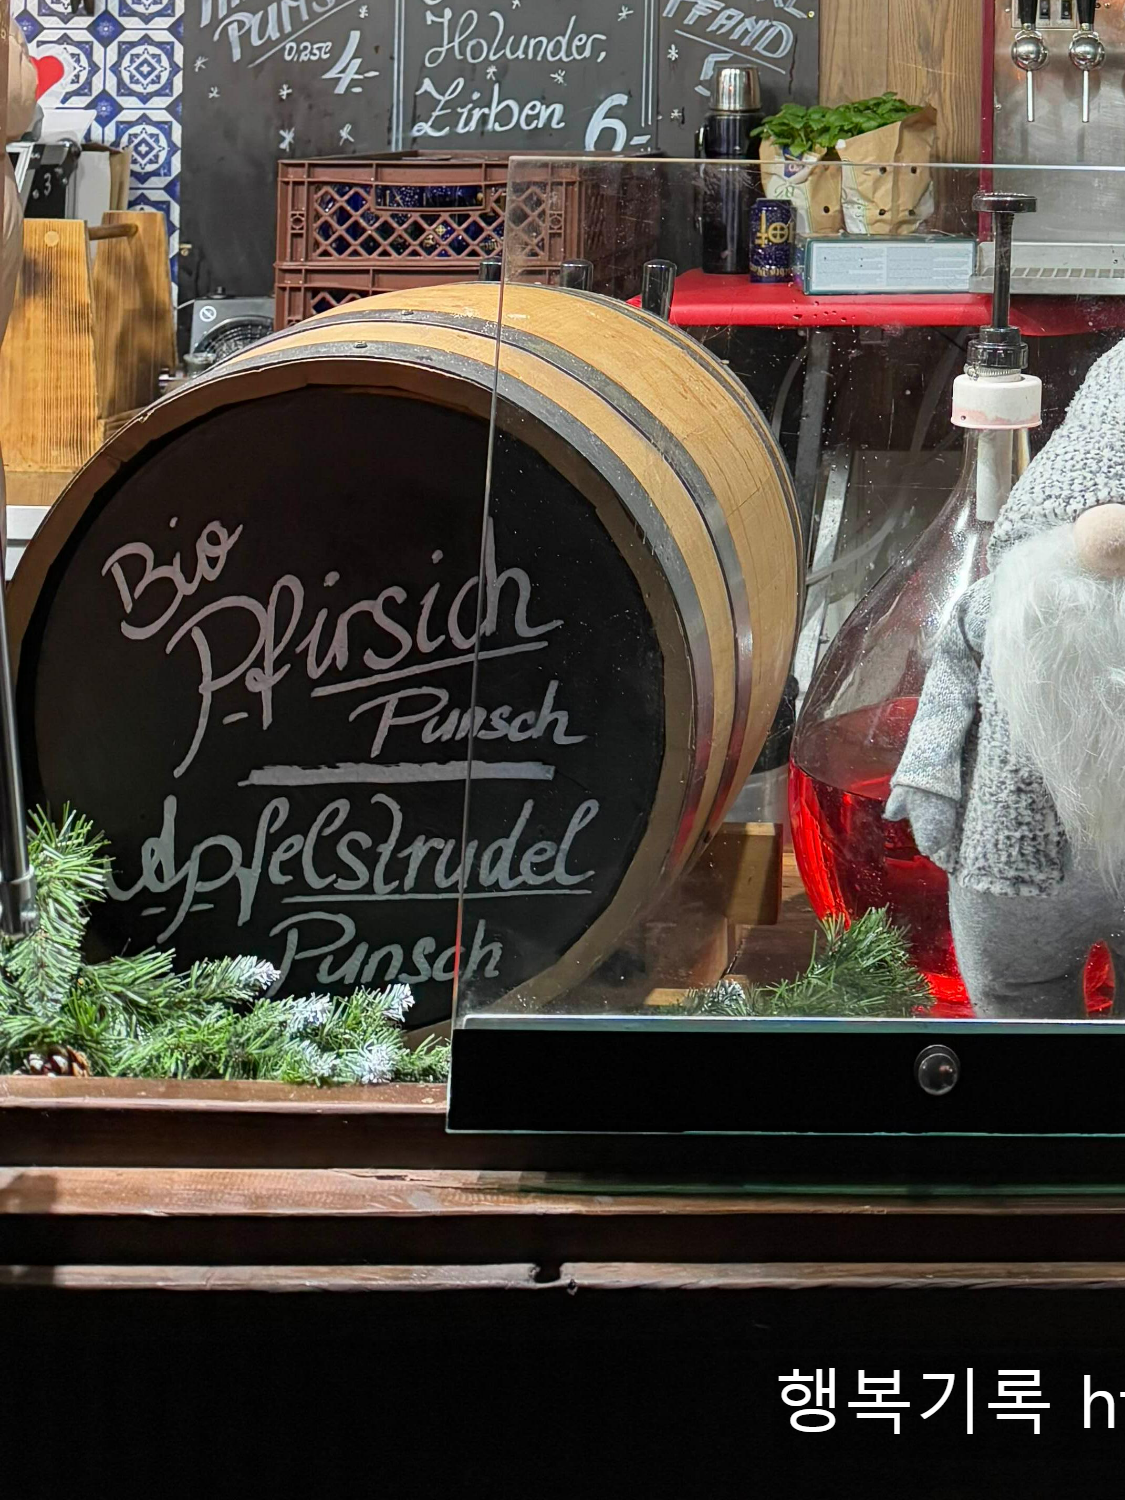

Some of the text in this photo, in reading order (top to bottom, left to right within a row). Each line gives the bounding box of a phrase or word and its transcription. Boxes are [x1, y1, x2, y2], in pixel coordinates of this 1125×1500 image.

[425, 8, 607, 67] Holunder,
[411, 77, 565, 136] Zirben
[101, 517, 243, 640] Bio
[166, 515, 564, 777] Pfirsich
[349, 679, 587, 757] Punsch
[269, 911, 501, 997] Punsch
